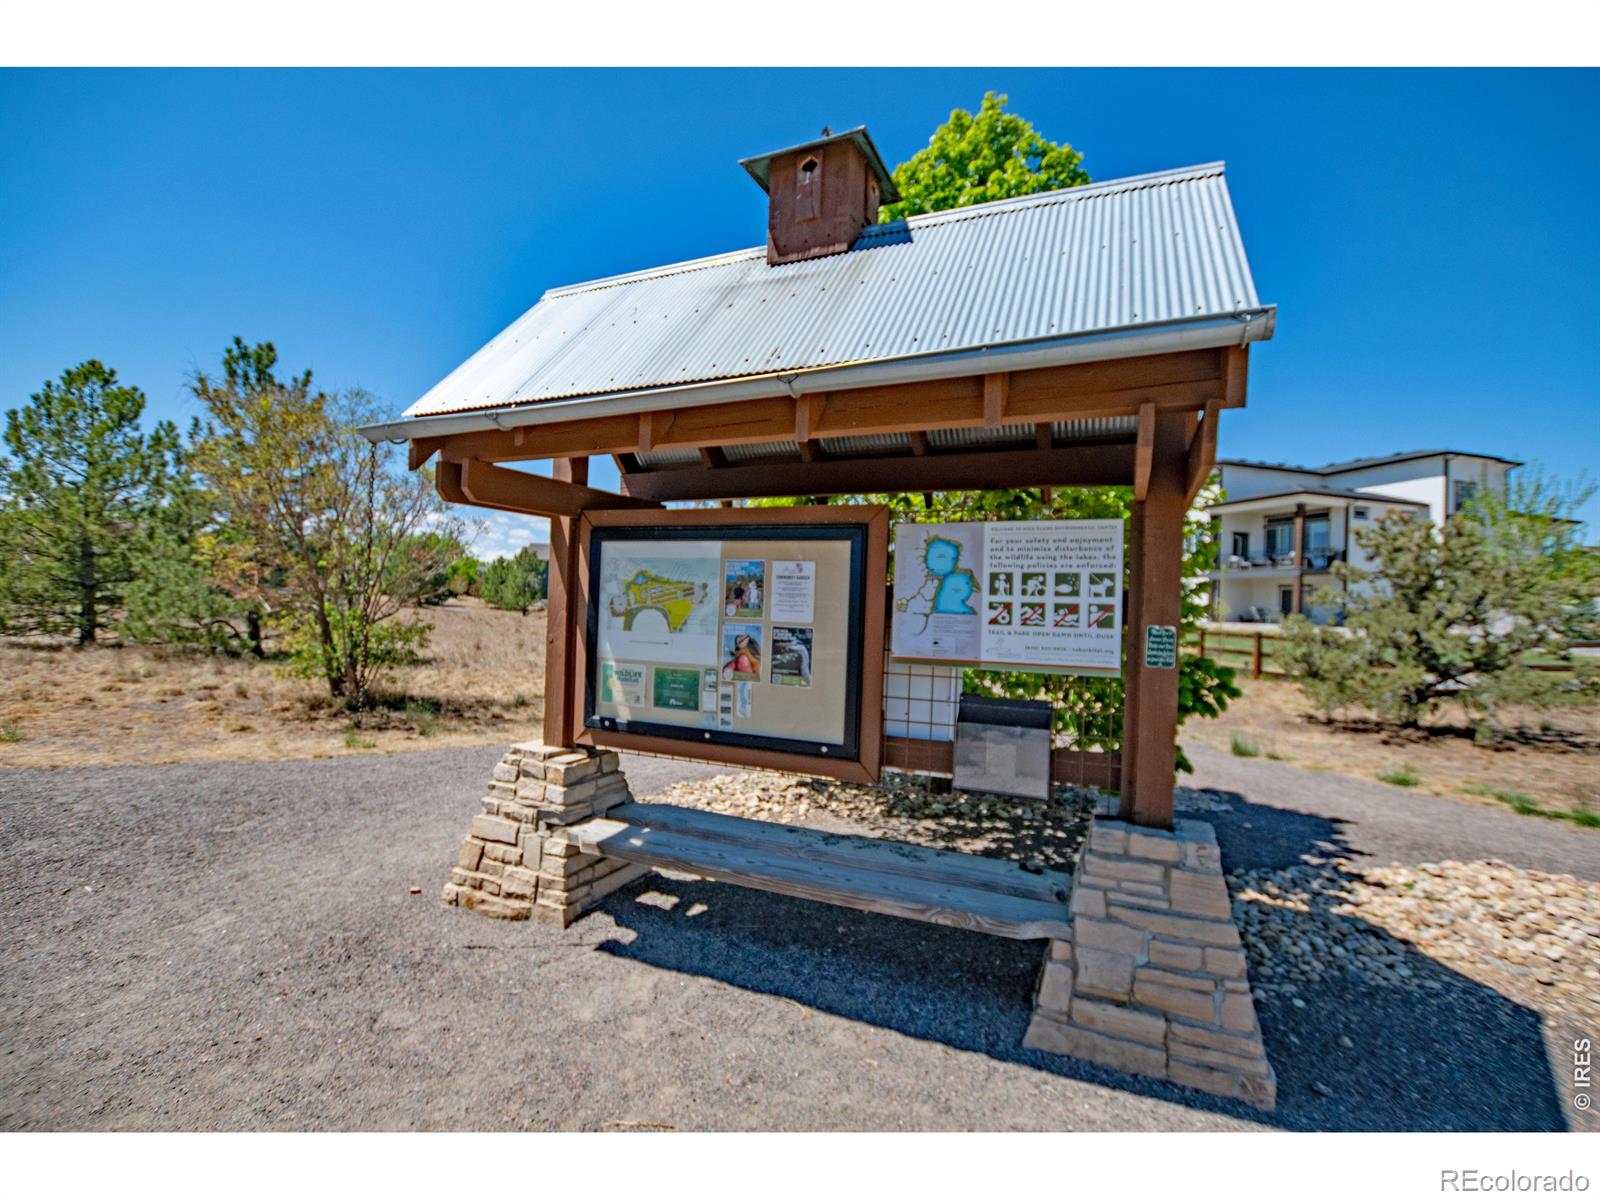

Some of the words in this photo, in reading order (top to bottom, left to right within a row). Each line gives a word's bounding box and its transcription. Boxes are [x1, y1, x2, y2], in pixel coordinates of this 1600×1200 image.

[1006, 538, 1022, 546] your
[1025, 537, 1050, 545] safety
[1070, 537, 1113, 545] enjoyment
[990, 562, 1025, 570] following
